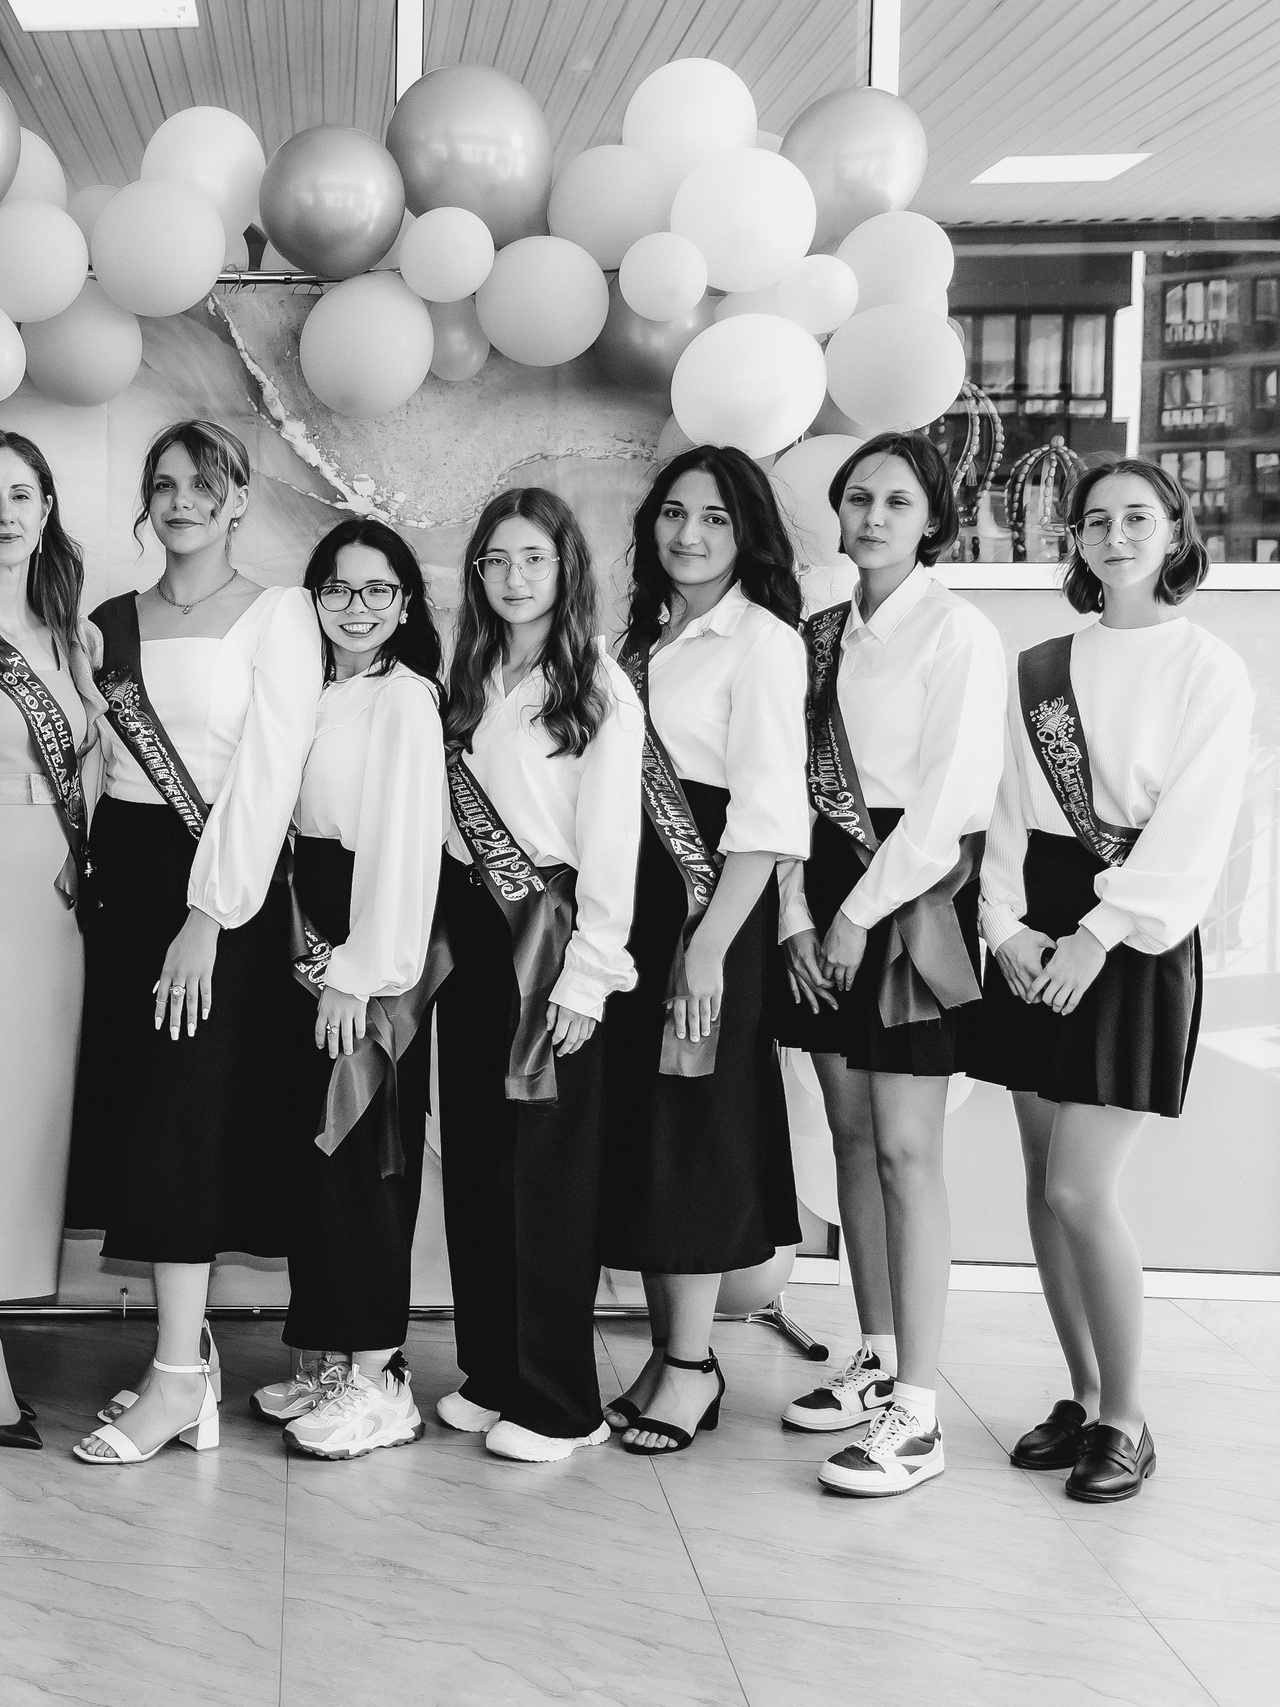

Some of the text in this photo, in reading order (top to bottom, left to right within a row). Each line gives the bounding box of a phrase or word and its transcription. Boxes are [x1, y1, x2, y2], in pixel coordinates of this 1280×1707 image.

[1, 670, 71, 801] ОВОДИТЕЛЬ
[6, 651, 72, 751] Классный
[471, 829, 547, 902] 2025
